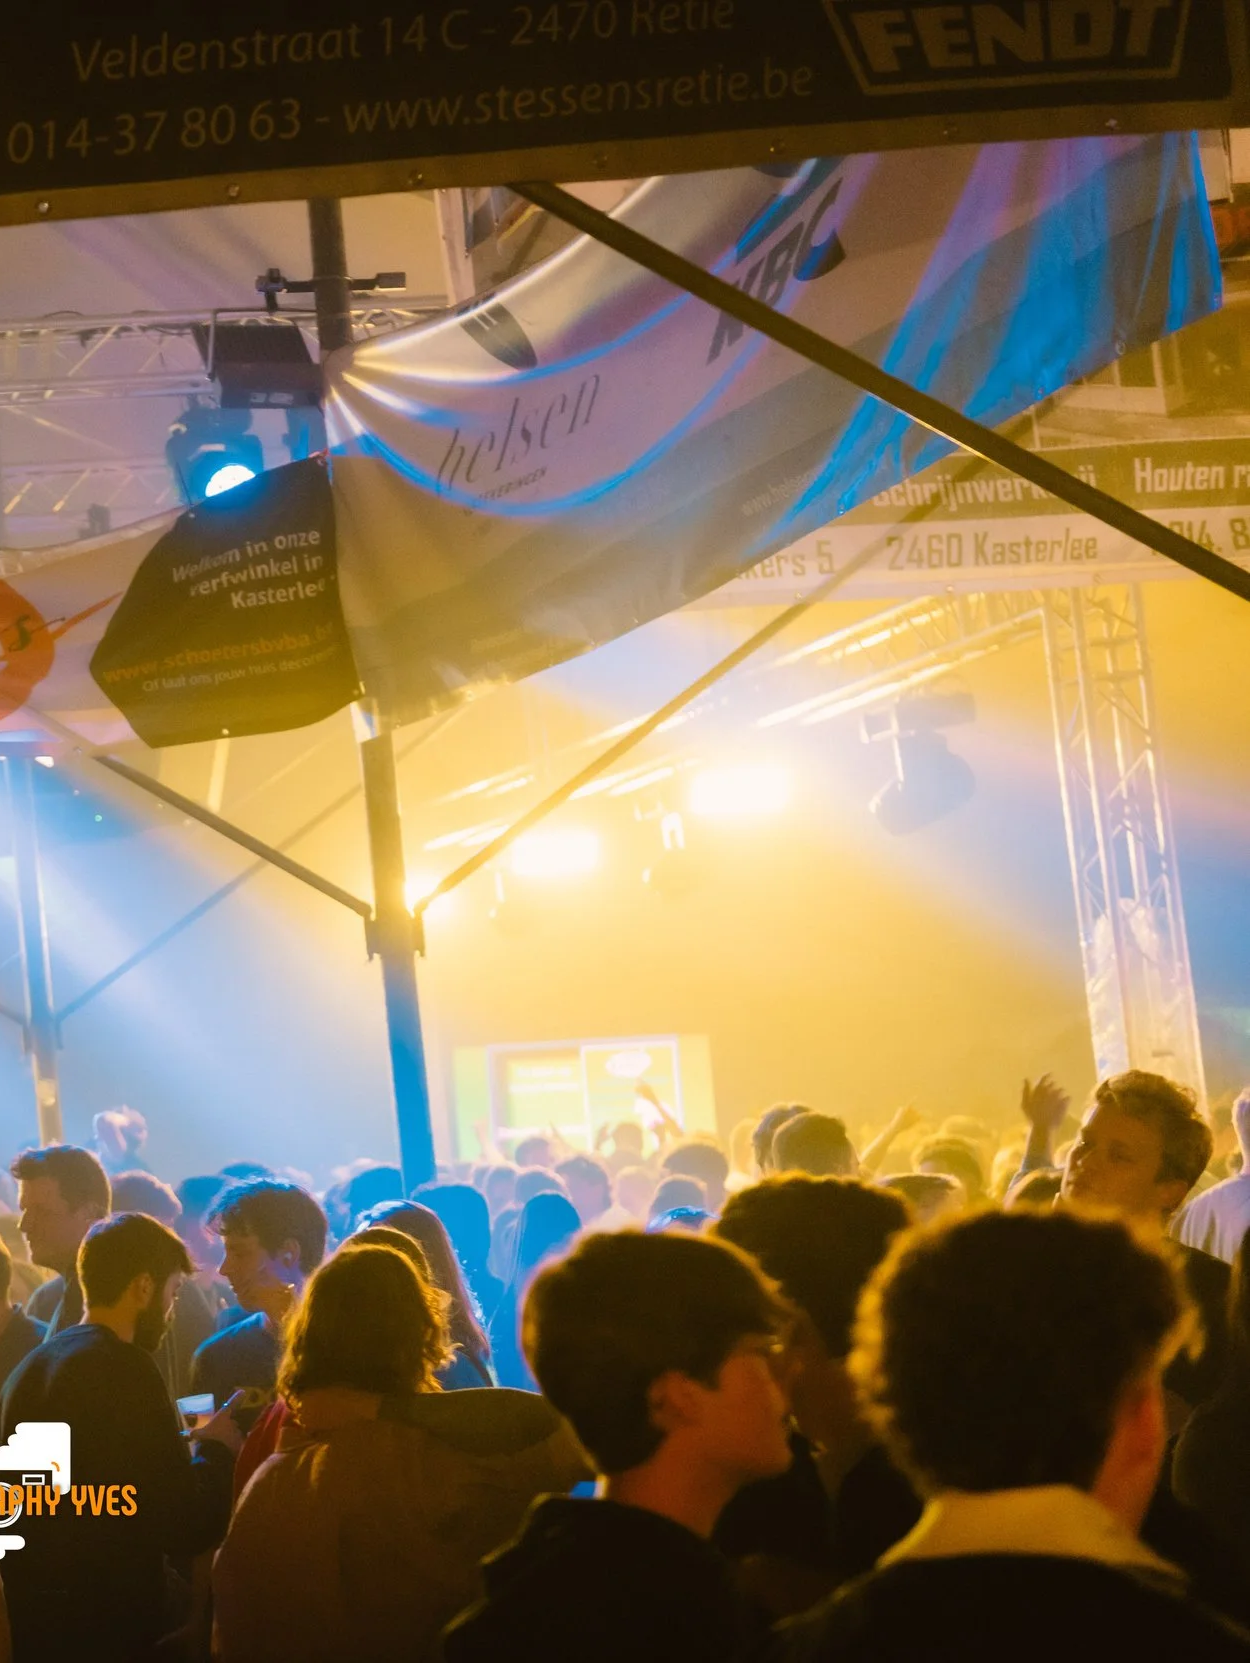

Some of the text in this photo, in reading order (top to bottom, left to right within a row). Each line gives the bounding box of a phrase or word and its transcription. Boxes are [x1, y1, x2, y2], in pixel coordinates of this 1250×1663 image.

[70, 22, 364, 83] Veldenstraat
[381, 13, 428, 57] 14
[442, 9, 471, 52] C
[509, 1, 618, 48] 2470
[630, 0, 735, 38] Retie
[853, 0, 1174, 73] FENDT
[7, 108, 168, 164] 014-37
[180, 102, 237, 149] 80
[249, 97, 301, 142] 63
[343, 56, 816, 135] www.stessensretie.be
[1134, 457, 1226, 494] Houten
[172, 529, 321, 583] Welkom in onze
[816, 540, 835, 575] 5
[886, 527, 1098, 571] 2460 Kasterlee
